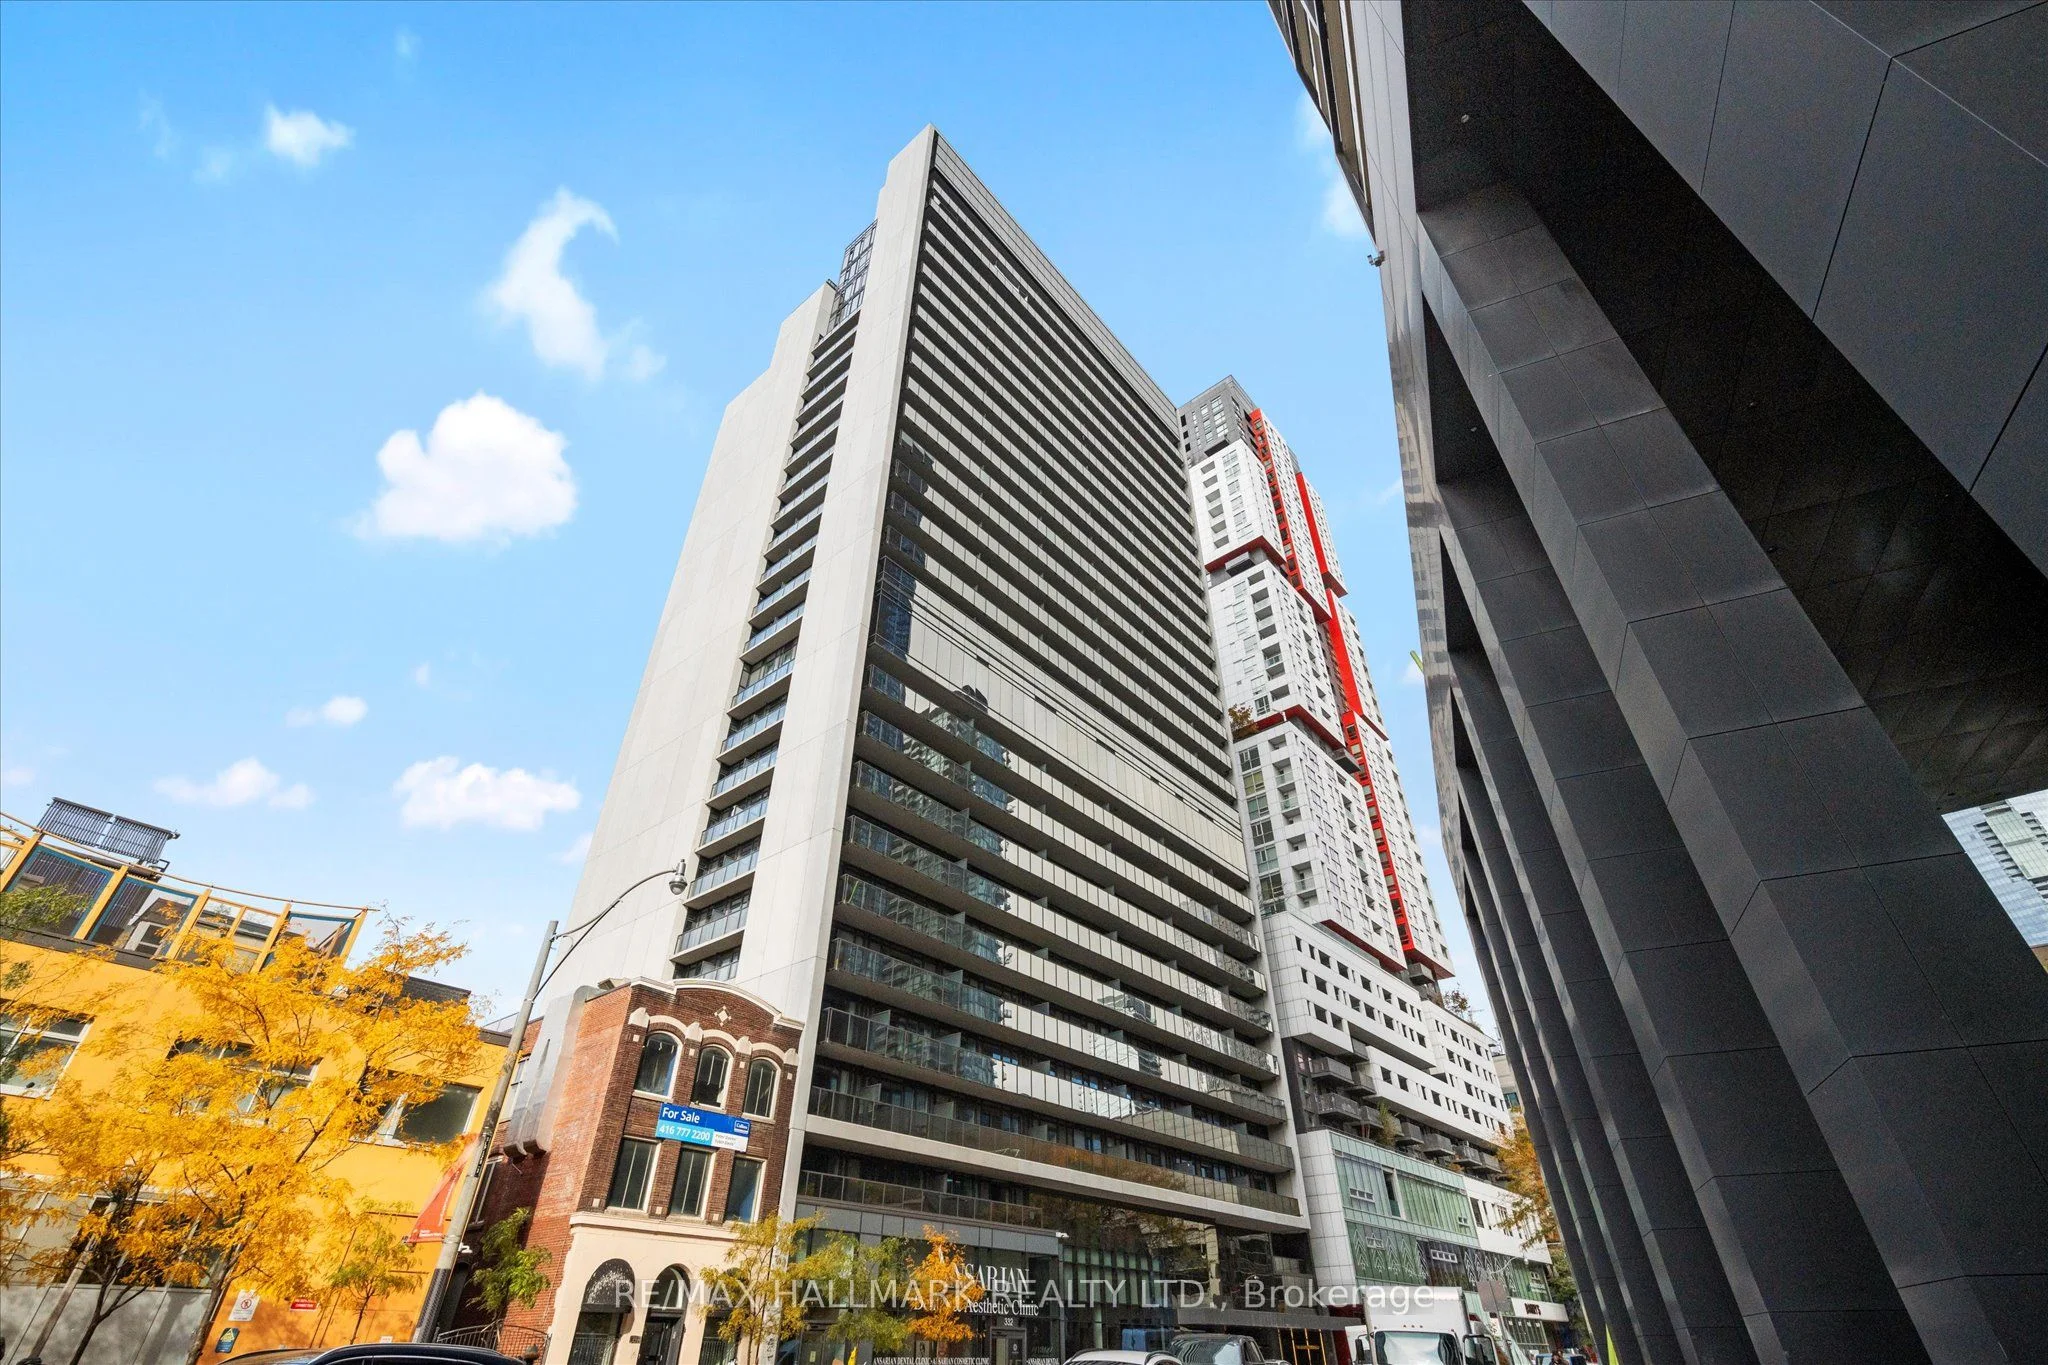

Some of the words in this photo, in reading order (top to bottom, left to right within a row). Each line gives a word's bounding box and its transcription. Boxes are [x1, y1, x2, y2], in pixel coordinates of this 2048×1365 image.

[662, 1107, 680, 1120] For
[680, 1110, 700, 1124] Sale
[659, 1123, 675, 1134] 416
[676, 1126, 690, 1137] 777
[691, 1129, 711, 1141] 2200
[964, 1298, 1009, 1315] Aesthetic
[1011, 1299, 1039, 1316] Clinic
[1004, 1318, 1014, 1327] 332
